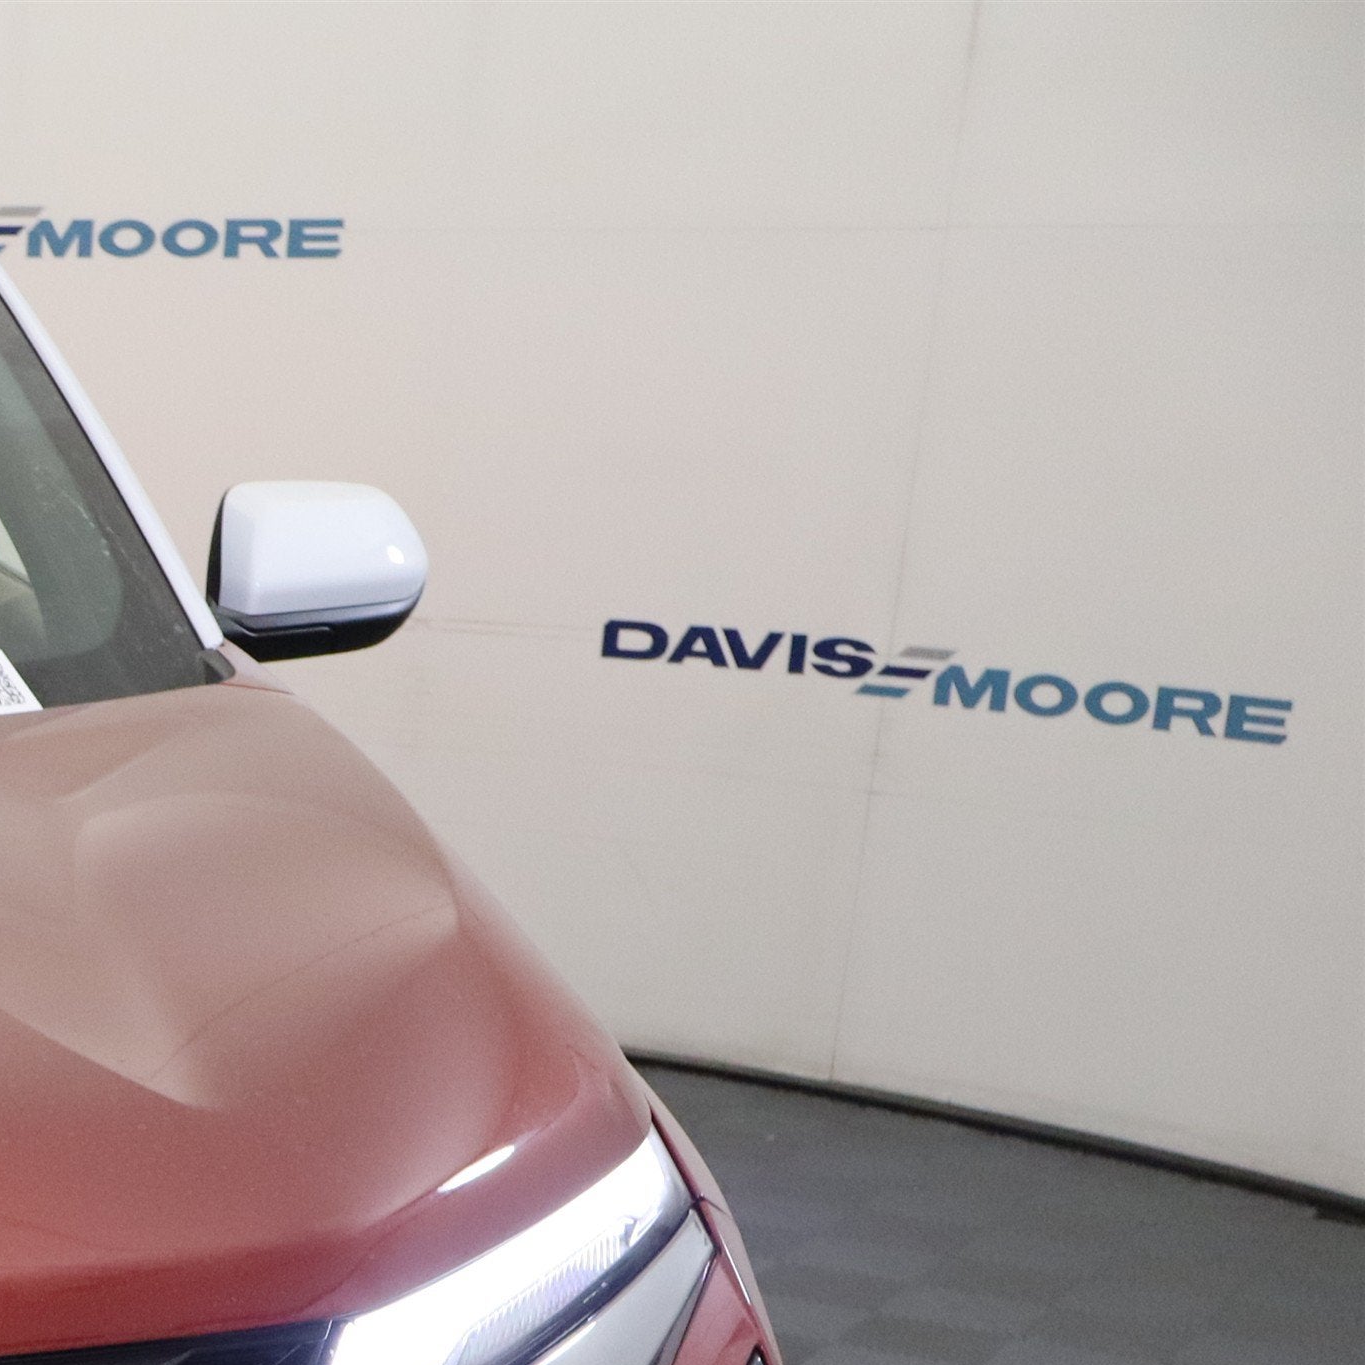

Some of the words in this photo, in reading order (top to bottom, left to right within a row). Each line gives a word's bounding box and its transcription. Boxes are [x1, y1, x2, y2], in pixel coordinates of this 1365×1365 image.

[26, 217, 345, 258] MOORE
[601, 618, 878, 679] DAVIS
[932, 664, 1294, 746] MOORE
